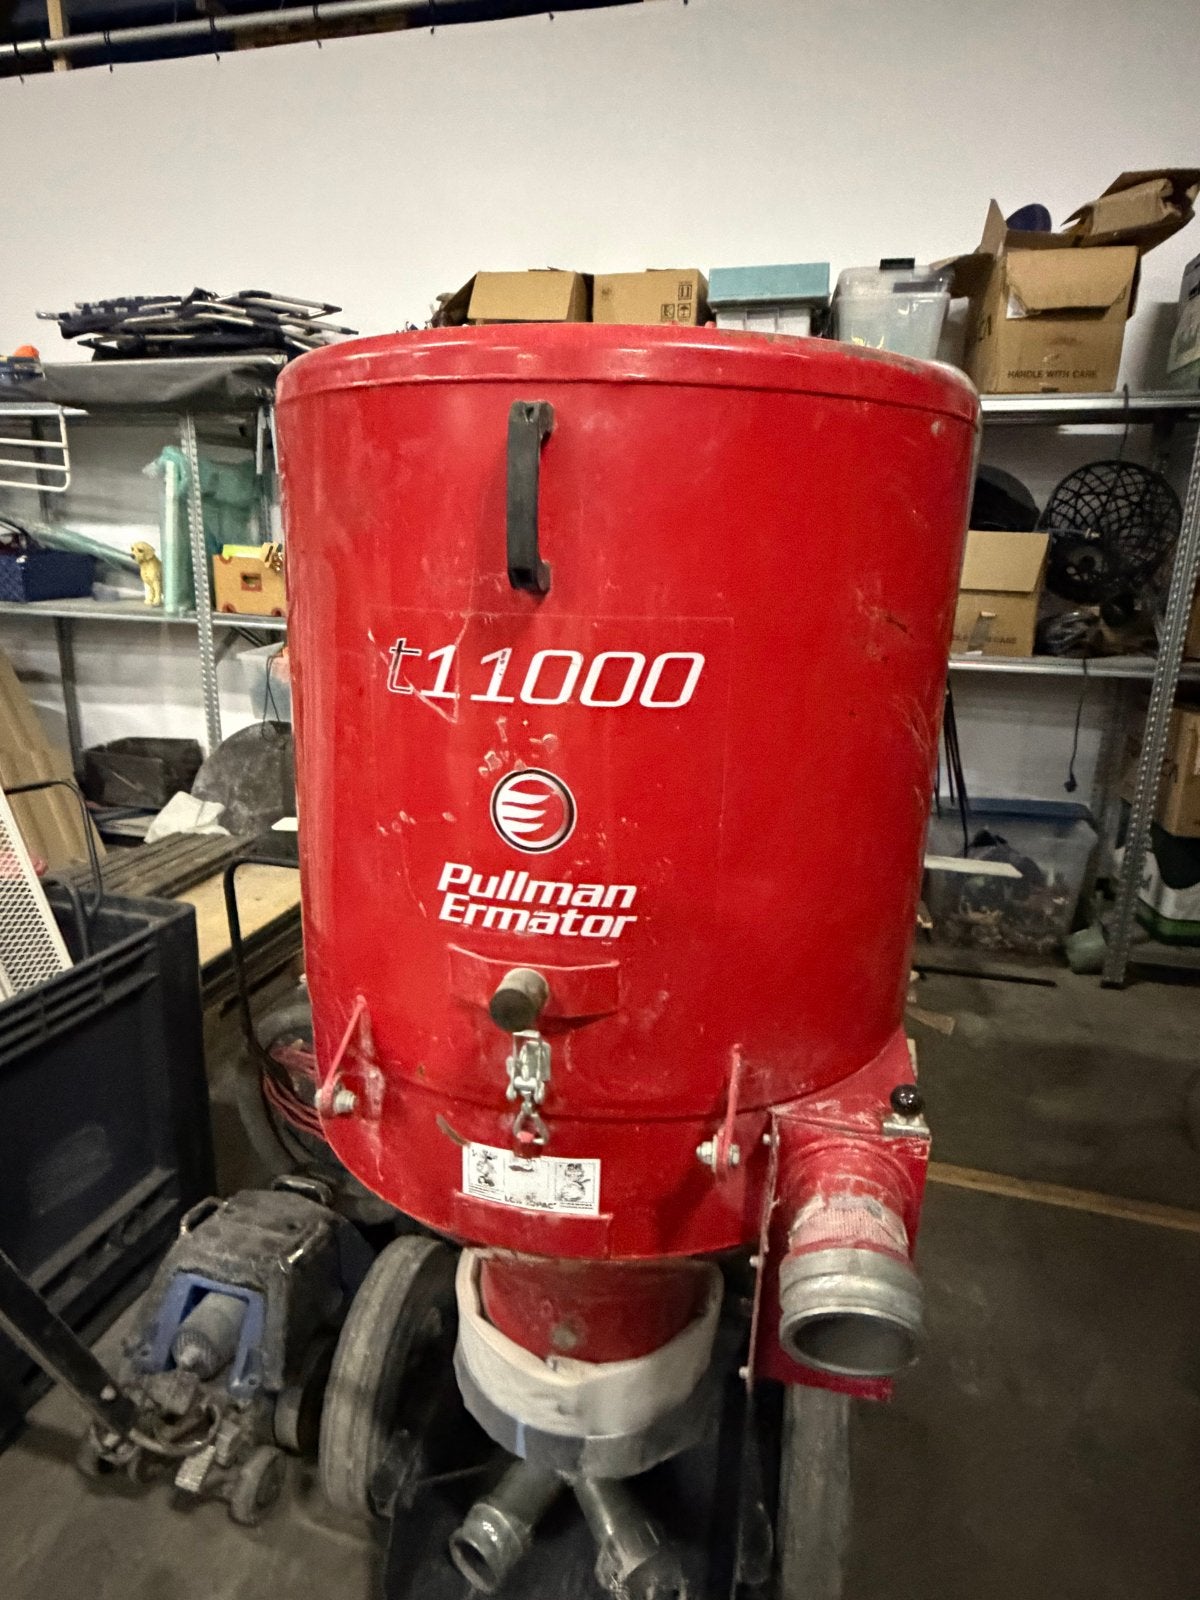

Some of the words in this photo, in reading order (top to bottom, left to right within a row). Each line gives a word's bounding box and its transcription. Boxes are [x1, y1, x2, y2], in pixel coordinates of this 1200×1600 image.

[1007, 369, 1042, 379] HANDLE
[1046, 369, 1070, 378] WITH
[1072, 369, 1097, 378] CARE
[436, 861, 638, 909] Pullman
[438, 892, 638, 938] Ermator
